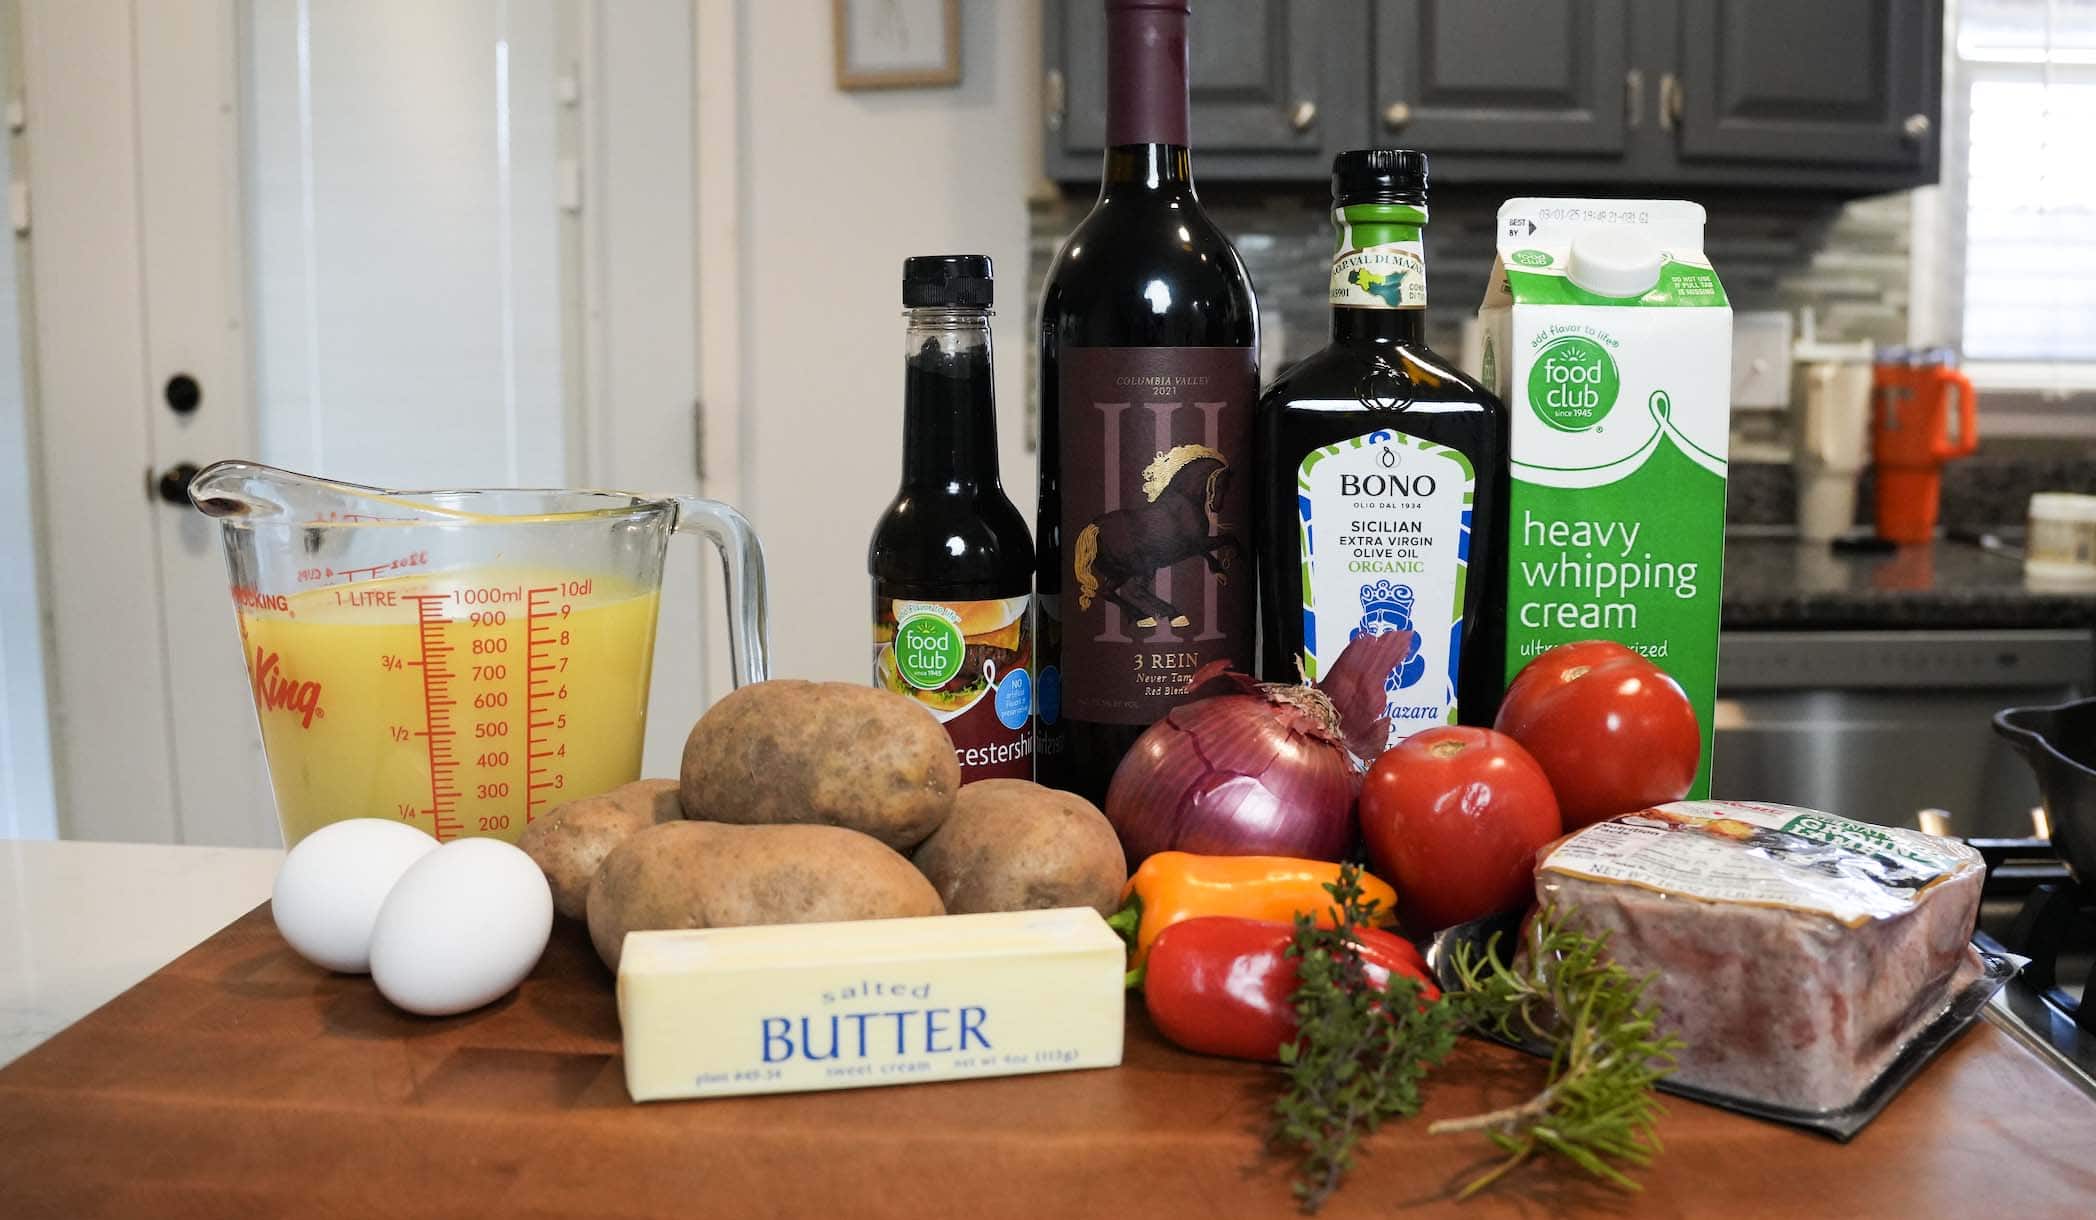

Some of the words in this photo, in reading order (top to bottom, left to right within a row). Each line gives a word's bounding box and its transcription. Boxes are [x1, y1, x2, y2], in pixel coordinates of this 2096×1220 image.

[1509, 218, 1526, 227] BEST
[1509, 229, 1519, 237] BY
[1350, 255, 1372, 268] VAL
[1375, 255, 1389, 264] DI
[1530, 330, 1549, 348] add
[1550, 324, 1581, 336] flavor
[1585, 325, 1596, 336] to
[1543, 358, 1602, 384] food
[1116, 375, 1171, 386] COLUMBIA
[1152, 386, 1177, 396] 2021
[1546, 383, 1599, 408] club
[1555, 409, 1573, 417] since
[1573, 408, 1592, 417] 1945
[1340, 474, 1437, 497] BONO
[1351, 520, 1423, 533] SICILIAN
[1522, 510, 1641, 557] heavy
[1340, 536, 1383, 546] EXTRA
[1387, 537, 1433, 546] VIRGIN
[1353, 548, 1393, 558] OLIVE
[1397, 549, 1419, 558] OIL
[1348, 560, 1425, 573] ORGANIC
[1520, 551, 1699, 599] whipping
[453, 584, 523, 604] 1000ml
[560, 578, 592, 597] 10dl
[335, 591, 342, 606] 1
[351, 591, 398, 607] LITRE
[470, 610, 507, 627] 900
[560, 604, 571, 620] 9
[1519, 602, 1638, 629] cream
[472, 638, 508, 655] 800
[560, 630, 570, 646] 8
[905, 629, 950, 651] food
[381, 655, 403, 671] 3/4
[559, 657, 569, 673] 7
[907, 649, 947, 670] club
[1133, 653, 1144, 671] 3
[472, 664, 507, 682] 700
[1136, 672, 1168, 684] Never
[1170, 672, 1192, 683] Tam
[255, 645, 322, 730] King
[558, 683, 568, 700] 6
[1011, 678, 1023, 690] NO
[1144, 687, 1161, 696] Red
[474, 692, 509, 709] 600
[475, 721, 509, 738] 500
[557, 714, 567, 729] 5
[390, 726, 409, 742] 1/2
[556, 743, 566, 758] 4
[955, 731, 1033, 767] cestershir
[476, 751, 510, 768] 400
[554, 774, 564, 789] 3
[476, 782, 509, 800] 300
[398, 804, 416, 820] 1/4
[479, 815, 510, 832] 200
[822, 981, 931, 1004] salted
[762, 1005, 992, 1064] BUTTER
[826, 1063, 873, 1078] sweet
[880, 1060, 931, 1075] cream
[953, 1057, 976, 1069] net
[980, 1056, 997, 1067] wt
